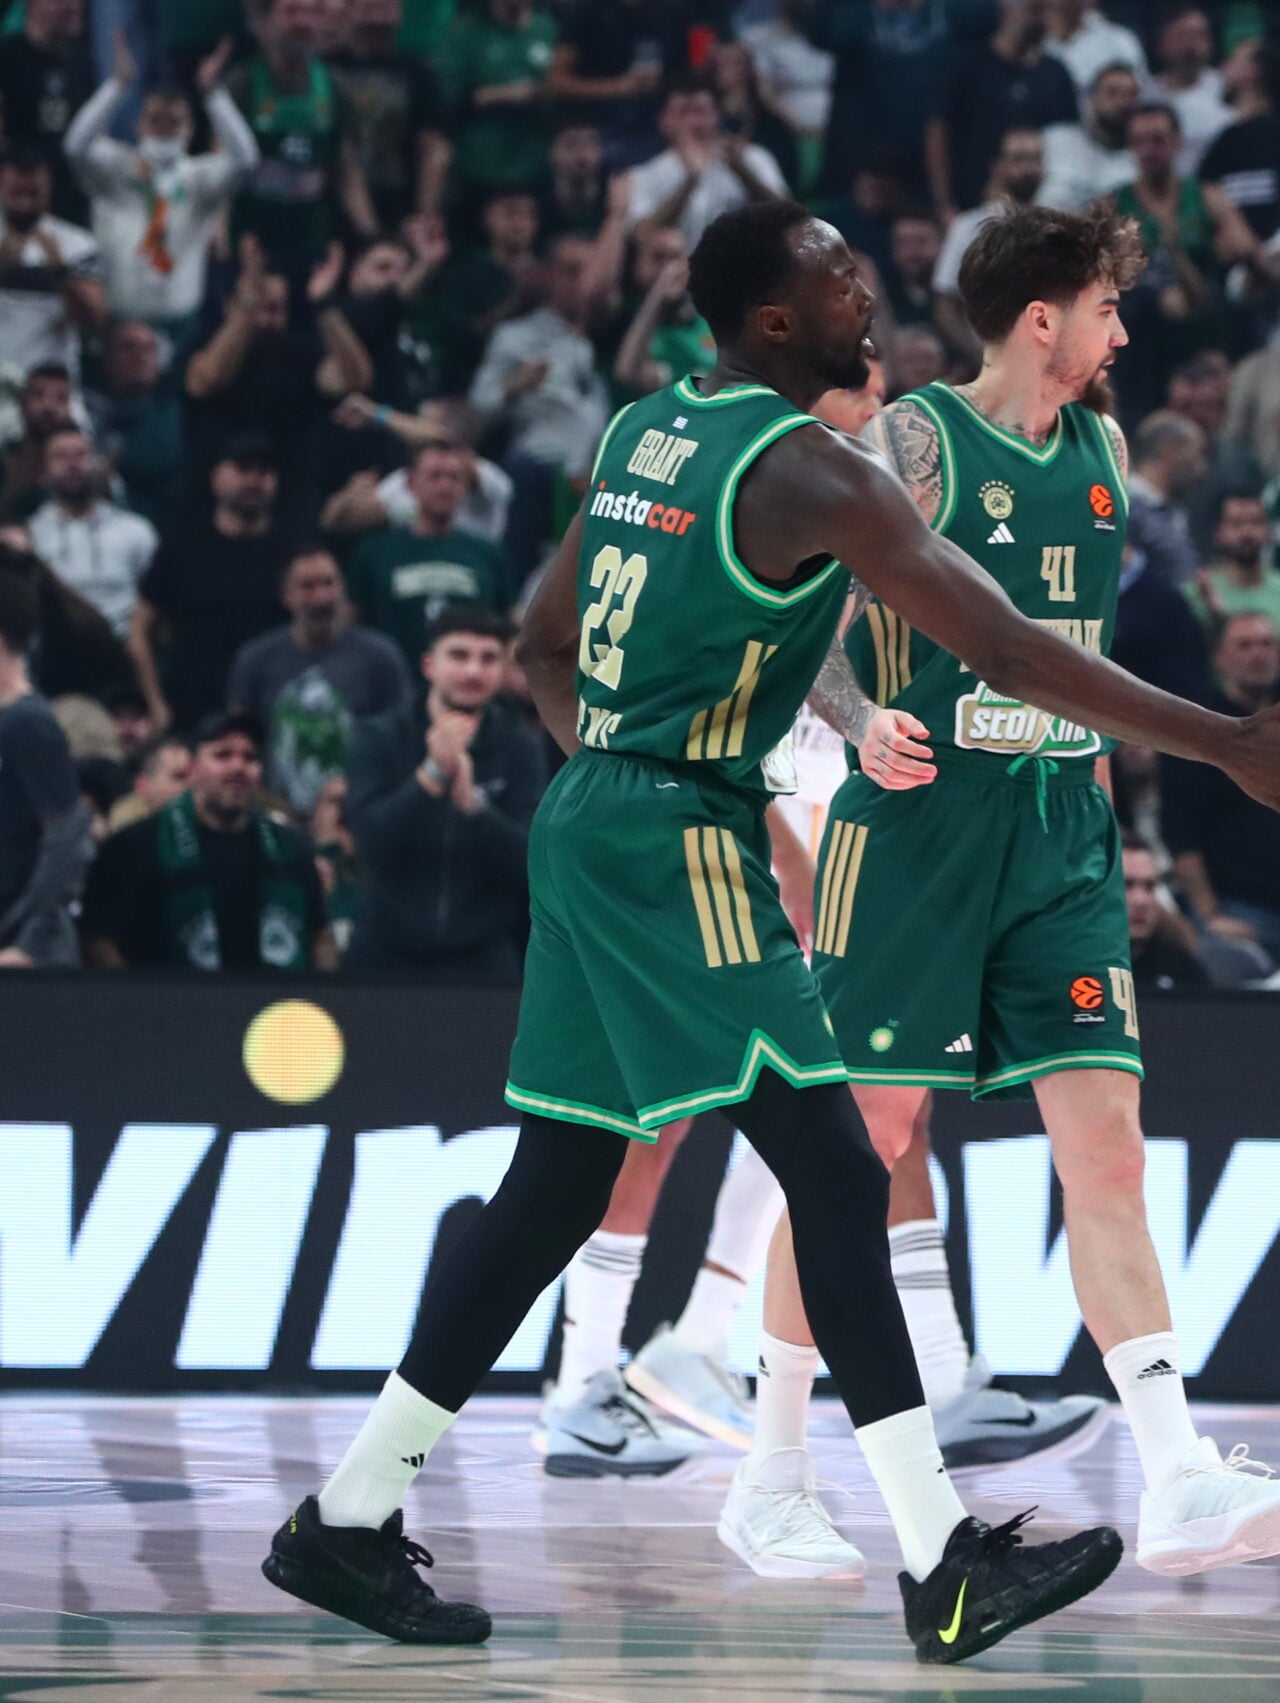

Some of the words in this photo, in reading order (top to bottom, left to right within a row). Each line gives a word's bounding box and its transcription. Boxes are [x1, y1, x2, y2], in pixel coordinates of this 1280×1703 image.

[627, 428, 699, 486] GRANT
[590, 480, 697, 536] instacar
[1040, 546, 1076, 602] 41
